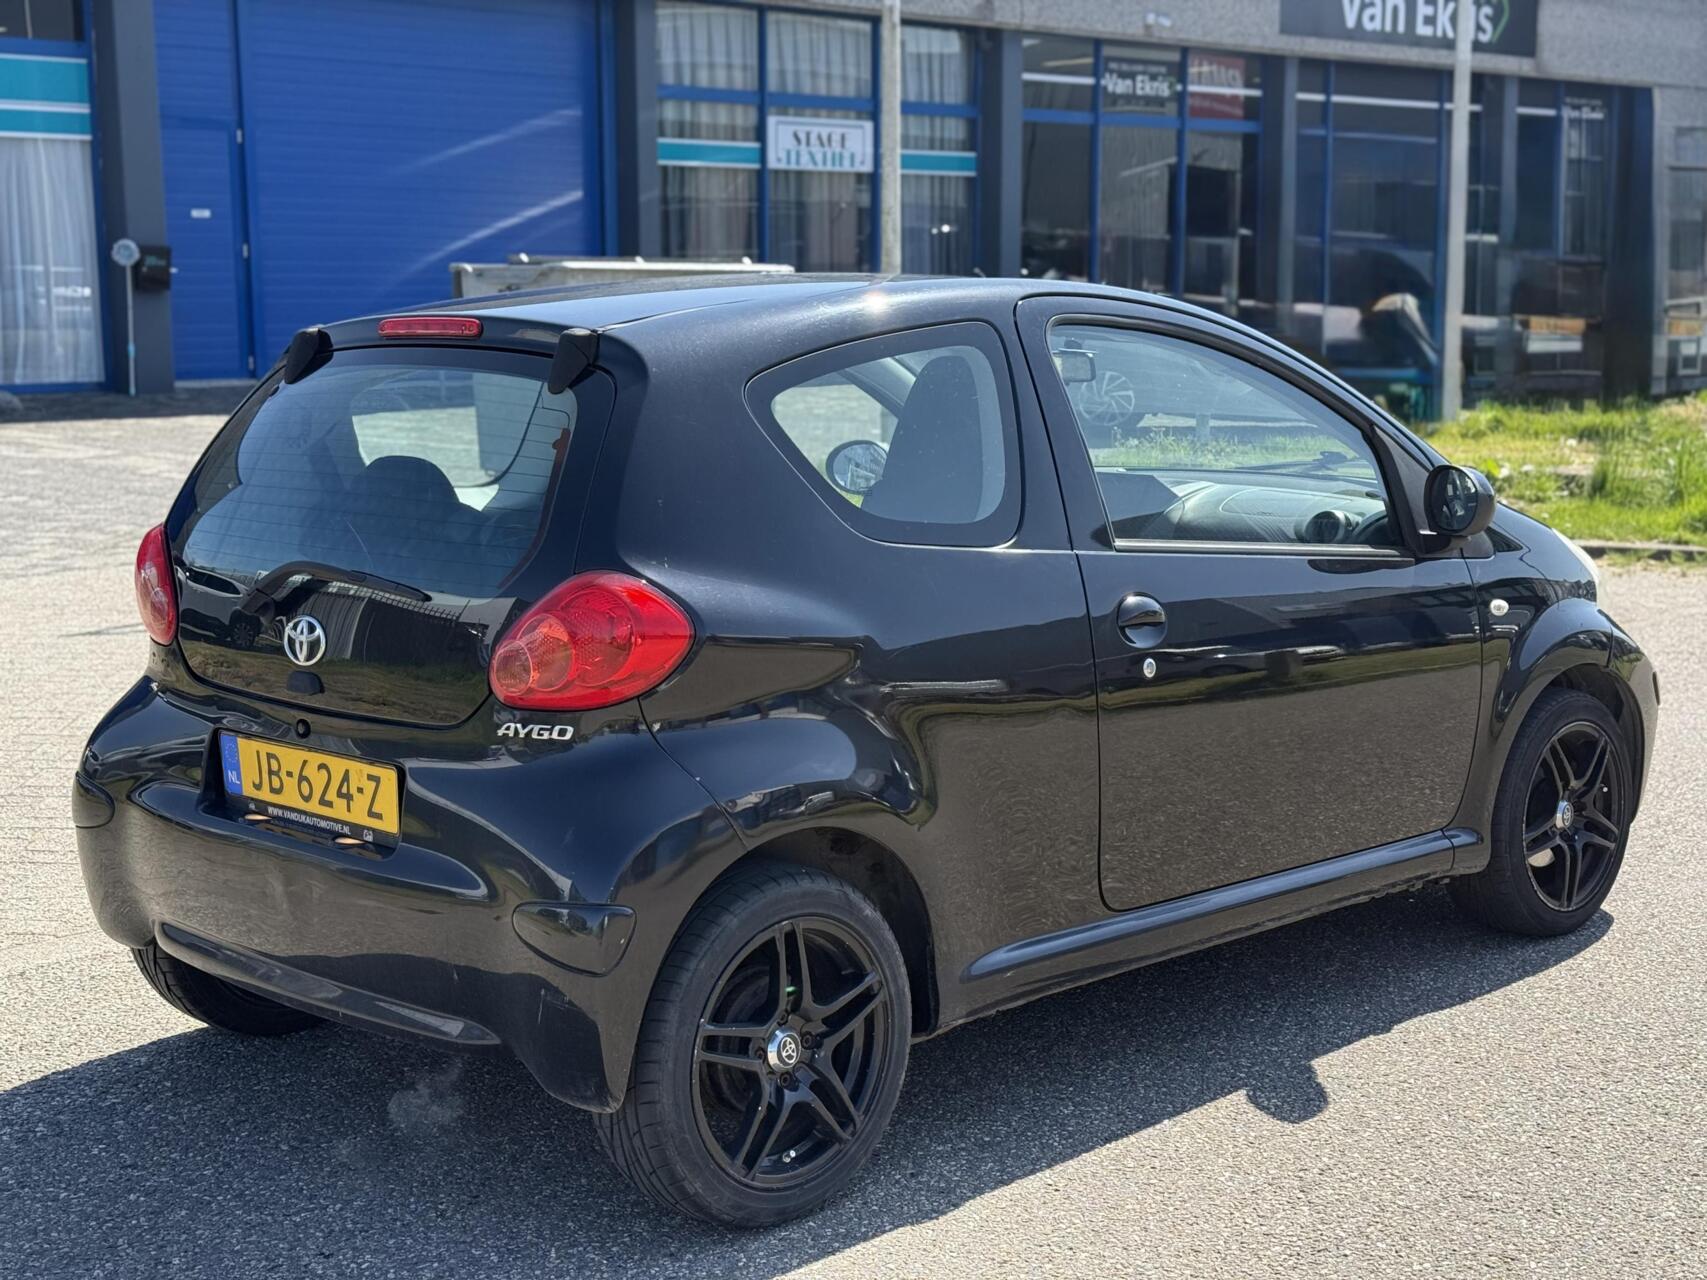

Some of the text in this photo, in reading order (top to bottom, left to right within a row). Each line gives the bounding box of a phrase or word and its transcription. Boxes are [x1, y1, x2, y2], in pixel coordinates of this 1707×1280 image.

[1342, 0, 1406, 33] Van
[1104, 72, 1134, 94] Van
[1135, 74, 1170, 97] Ekris
[792, 130, 850, 149] STAGE
[496, 722, 574, 740] AYGO
[228, 770, 241, 784] NL
[252, 750, 384, 821] JB-624-Z
